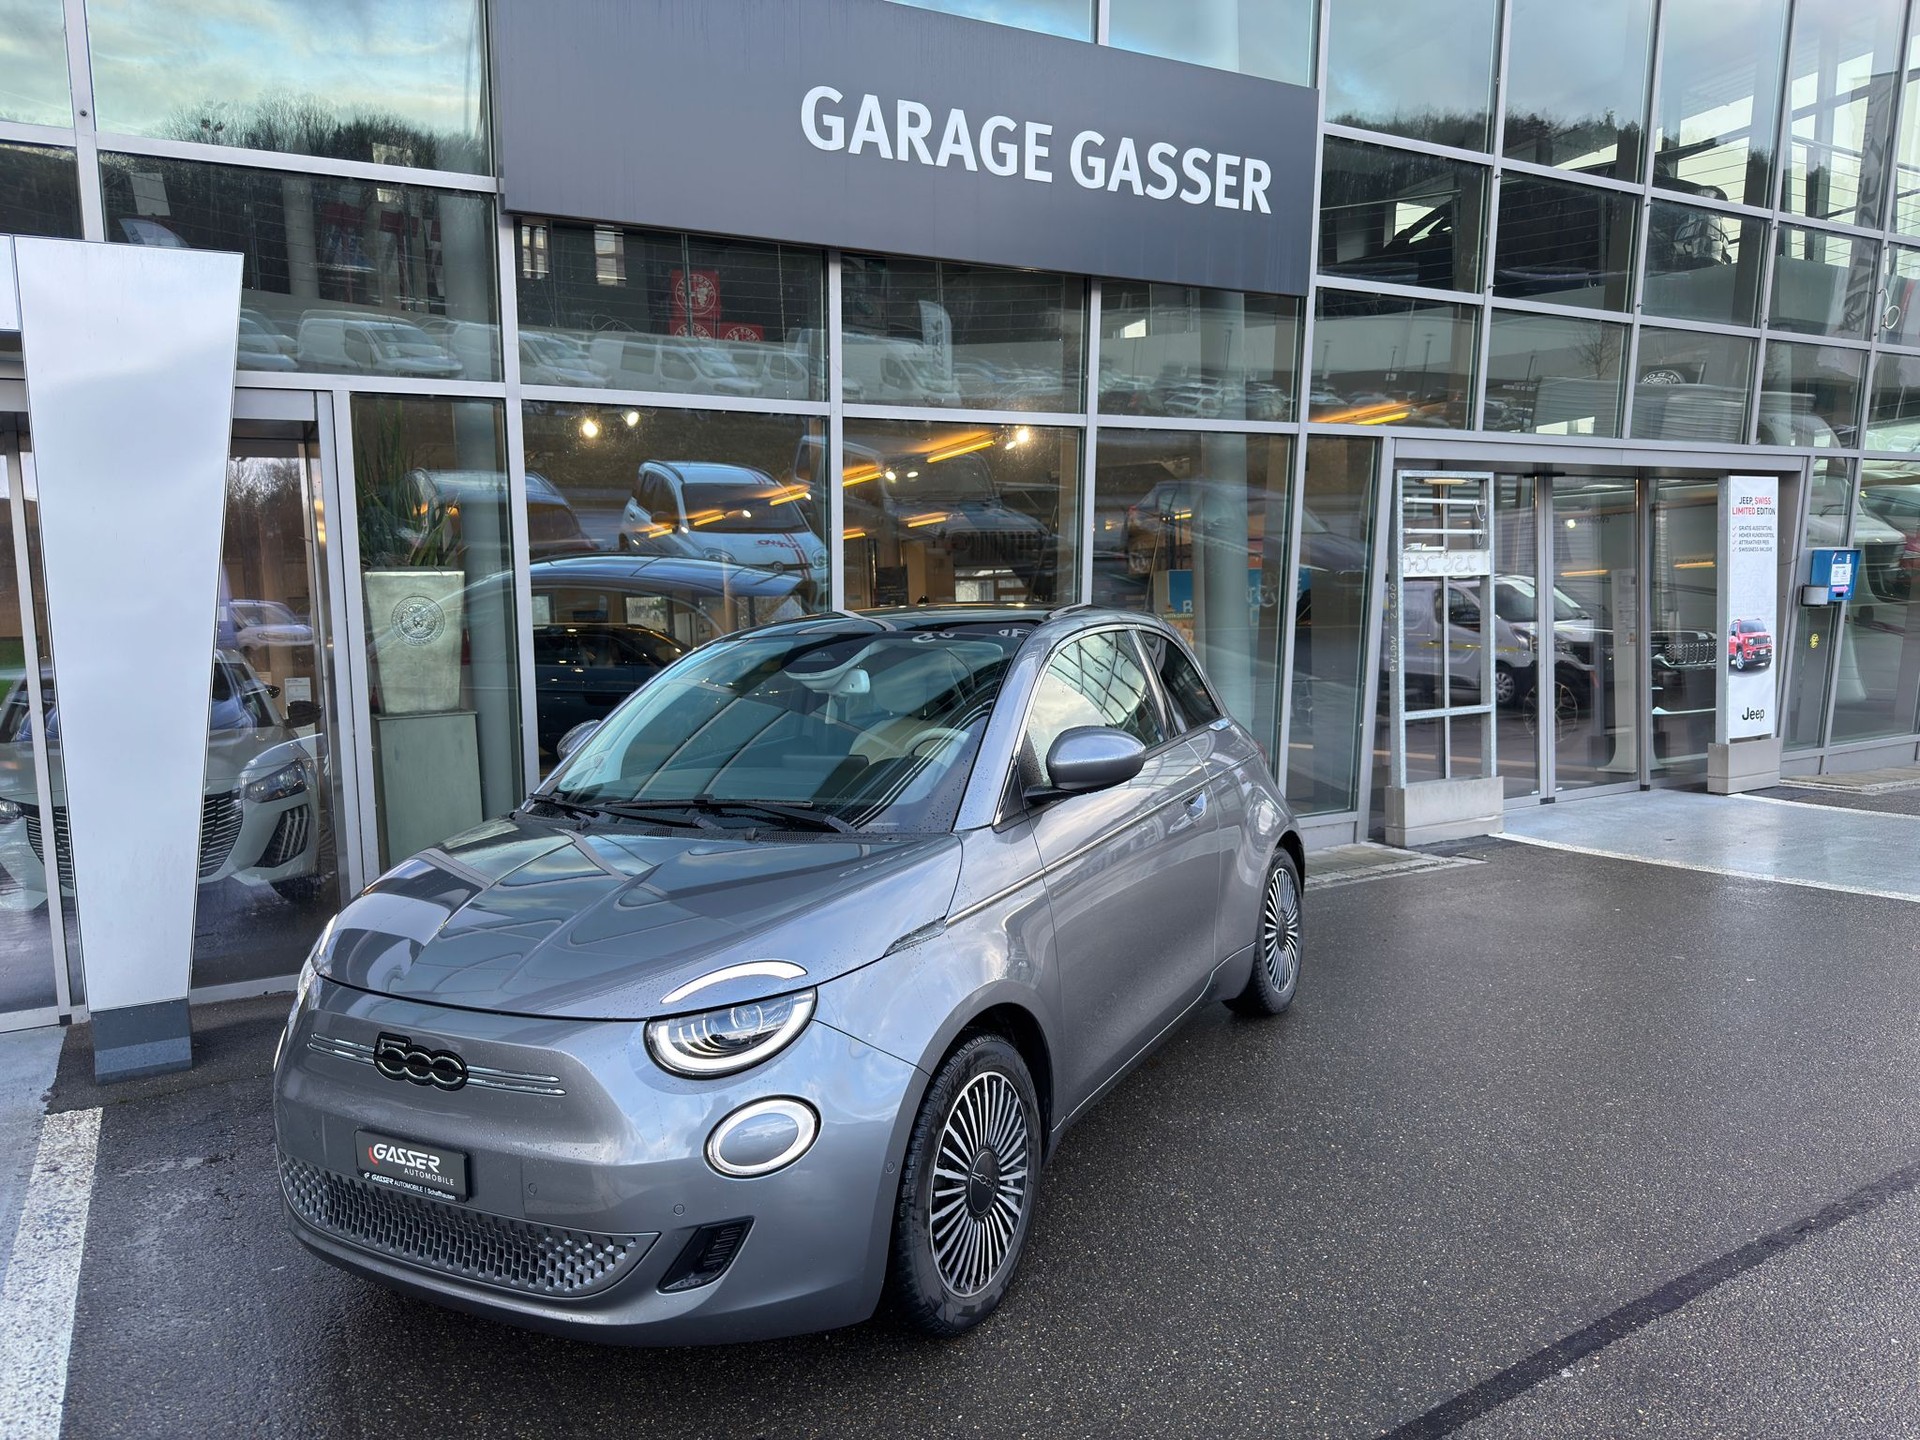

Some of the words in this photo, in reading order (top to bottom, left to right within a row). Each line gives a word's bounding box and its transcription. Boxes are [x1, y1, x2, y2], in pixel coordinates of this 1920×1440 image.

[801, 85, 1053, 183] GARAGE
[1069, 130, 1271, 214] GASSER
[1732, 507, 1756, 516] LIMITED
[1756, 507, 1776, 516] EDITION
[1755, 496, 1772, 505] SWISS
[1741, 706, 1765, 722] Jeep
[375, 1033, 467, 1089] 500
[373, 1143, 441, 1173] GASSER
[371, 1173, 394, 1184] GASSER
[394, 1180, 423, 1193] AUTOMOBILE
[427, 1187, 456, 1200] Schaffhausen
[404, 1167, 455, 1187] AUTOMOBILE
